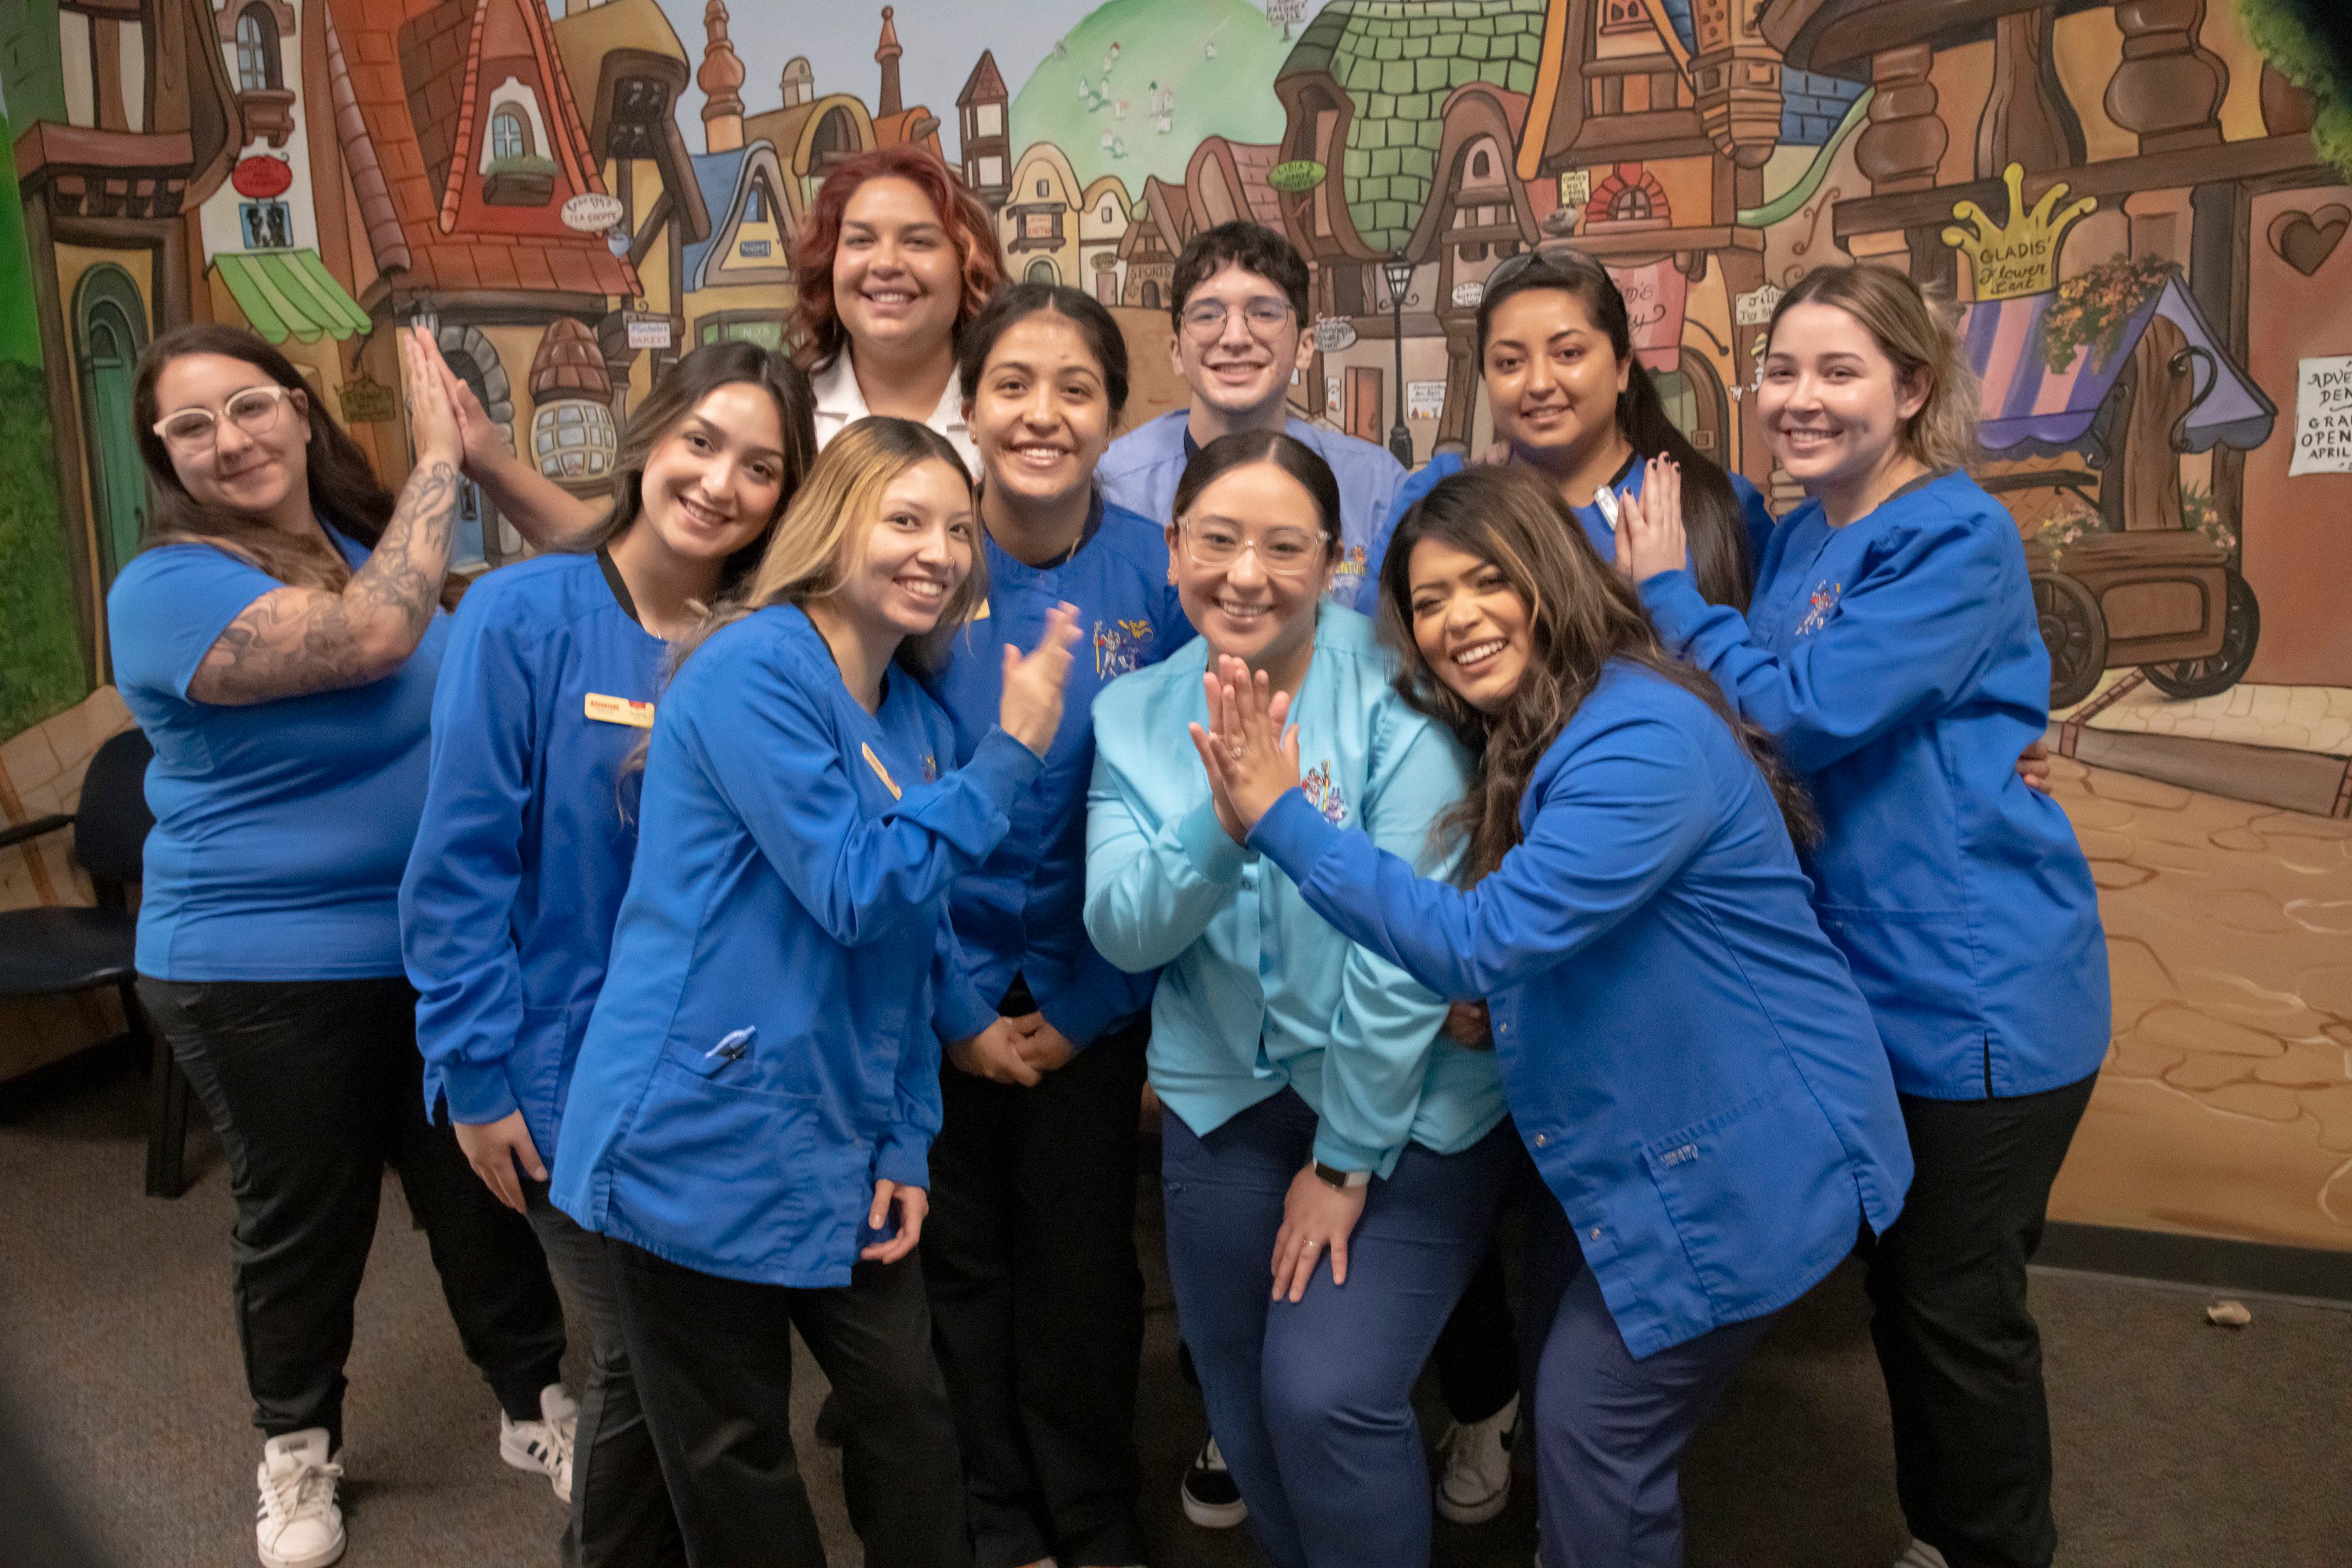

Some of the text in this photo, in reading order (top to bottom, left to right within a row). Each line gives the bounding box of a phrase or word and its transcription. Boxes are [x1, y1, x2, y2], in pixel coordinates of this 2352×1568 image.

[2308, 414, 2352, 429] GRA
[2301, 429, 2351, 447] OPEN
[2309, 447, 2351, 460] APRIL
